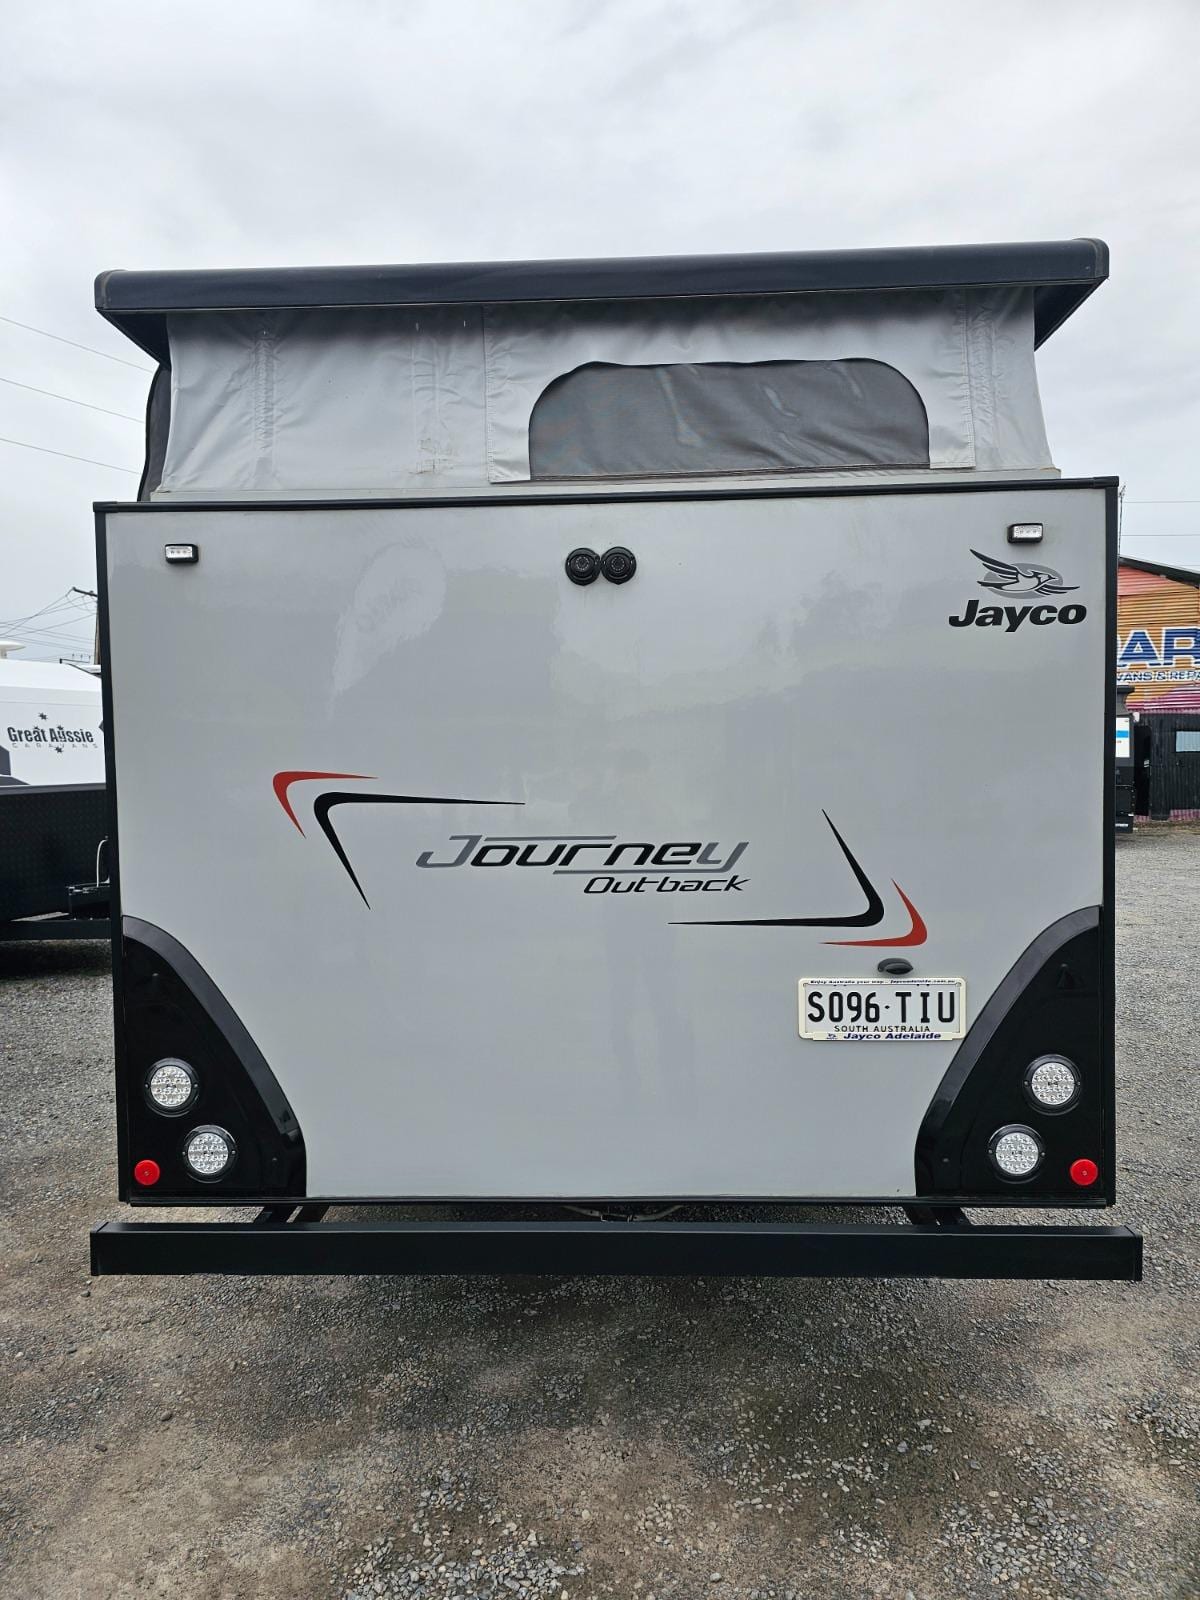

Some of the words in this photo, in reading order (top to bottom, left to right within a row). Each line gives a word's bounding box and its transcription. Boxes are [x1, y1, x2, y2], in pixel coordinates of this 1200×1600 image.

[948, 599, 1087, 632] Jayco
[1117, 627, 1200, 668] AR
[1156, 671, 1166, 681] &
[7, 726, 48, 742] Great
[49, 727, 94, 742] Aussie
[415, 834, 750, 874] Journey
[583, 874, 751, 894] Outback
[834, 1025, 869, 1033] SOUTH
[874, 1025, 931, 1033] AUSTRALIA
[843, 1032, 881, 1041] Jayco
[885, 1032, 942, 1040] Adelaide
